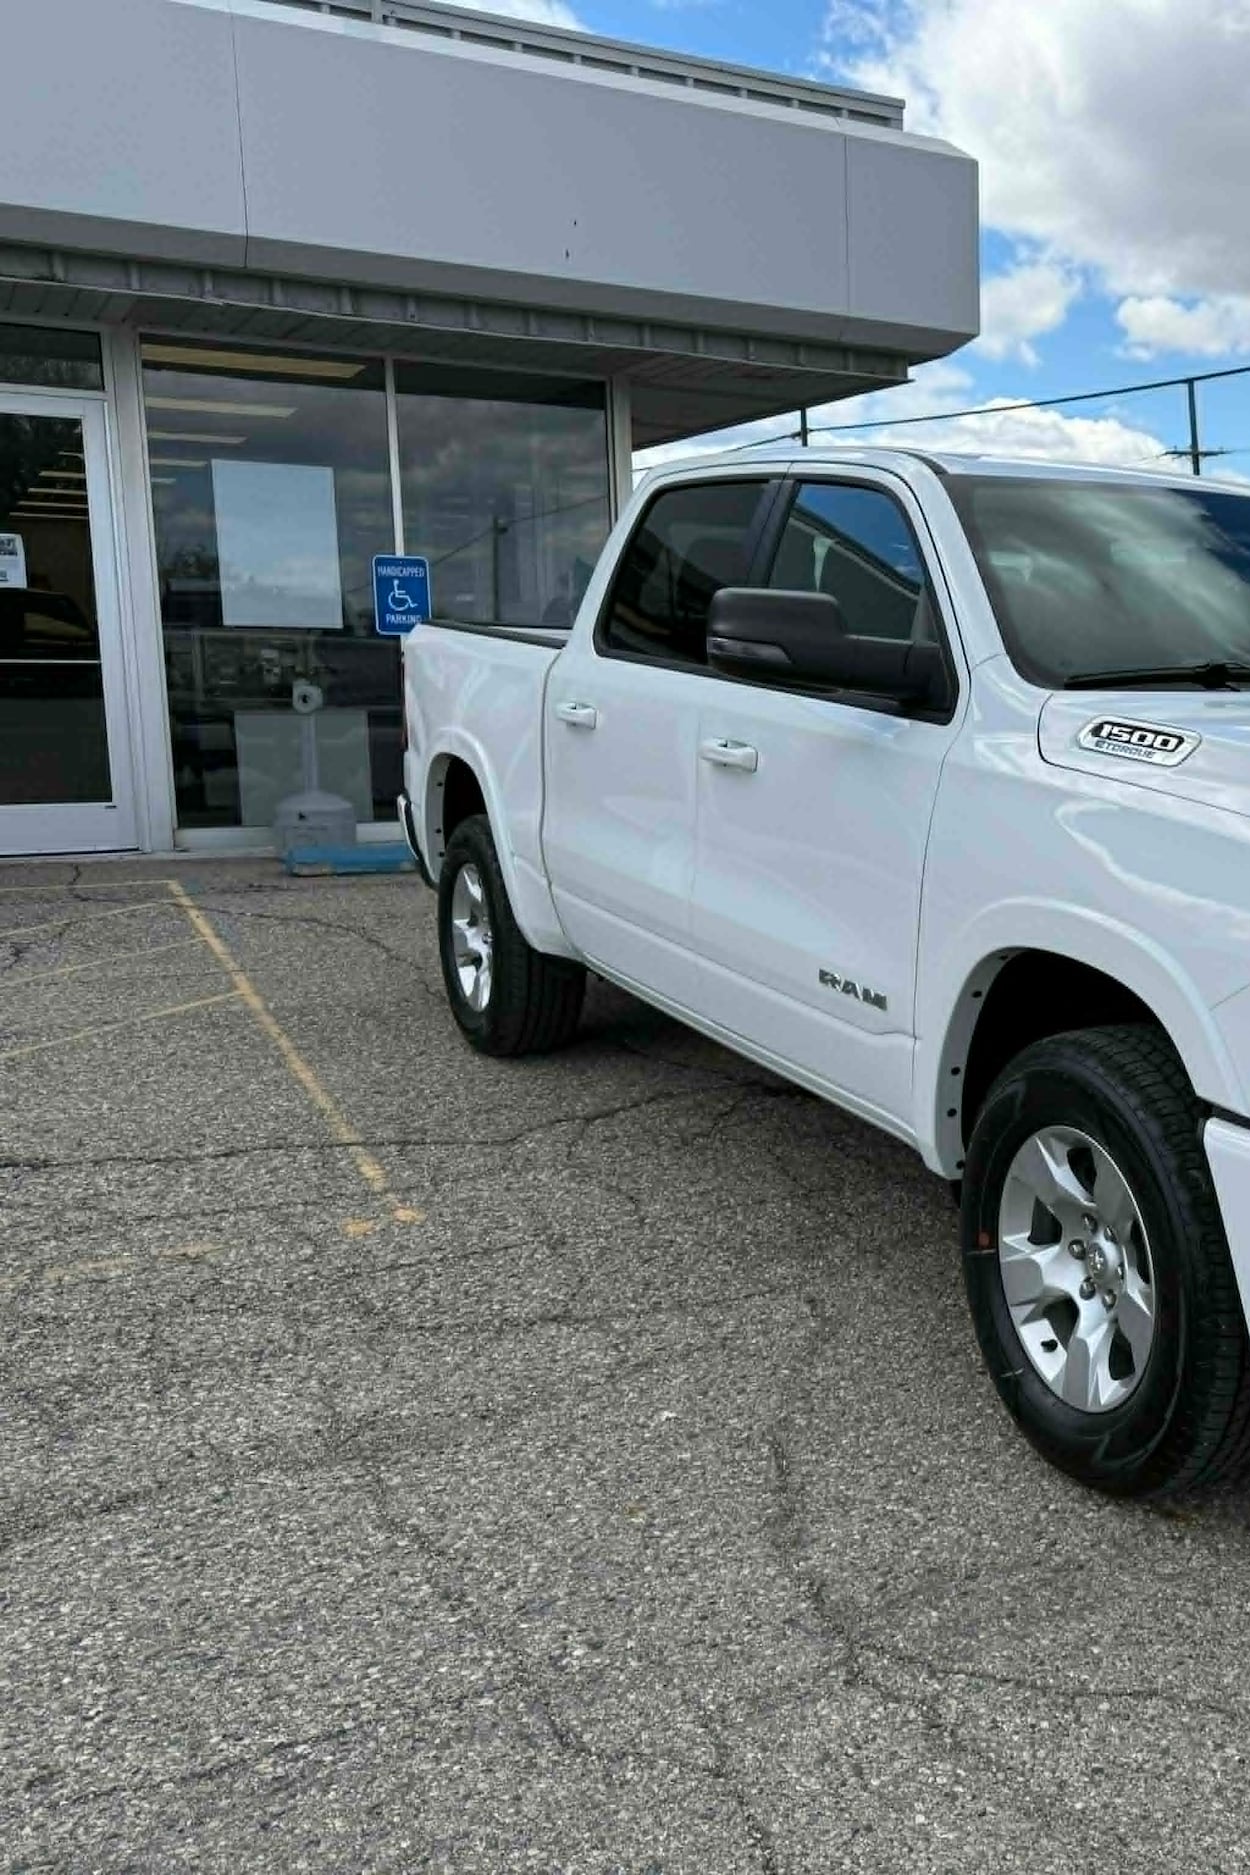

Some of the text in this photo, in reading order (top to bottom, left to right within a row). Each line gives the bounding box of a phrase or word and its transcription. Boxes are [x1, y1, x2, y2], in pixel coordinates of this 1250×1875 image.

[377, 565, 426, 577] HANDICAPPED
[1099, 722, 1181, 750] 1500
[818, 967, 888, 1012] RAM
